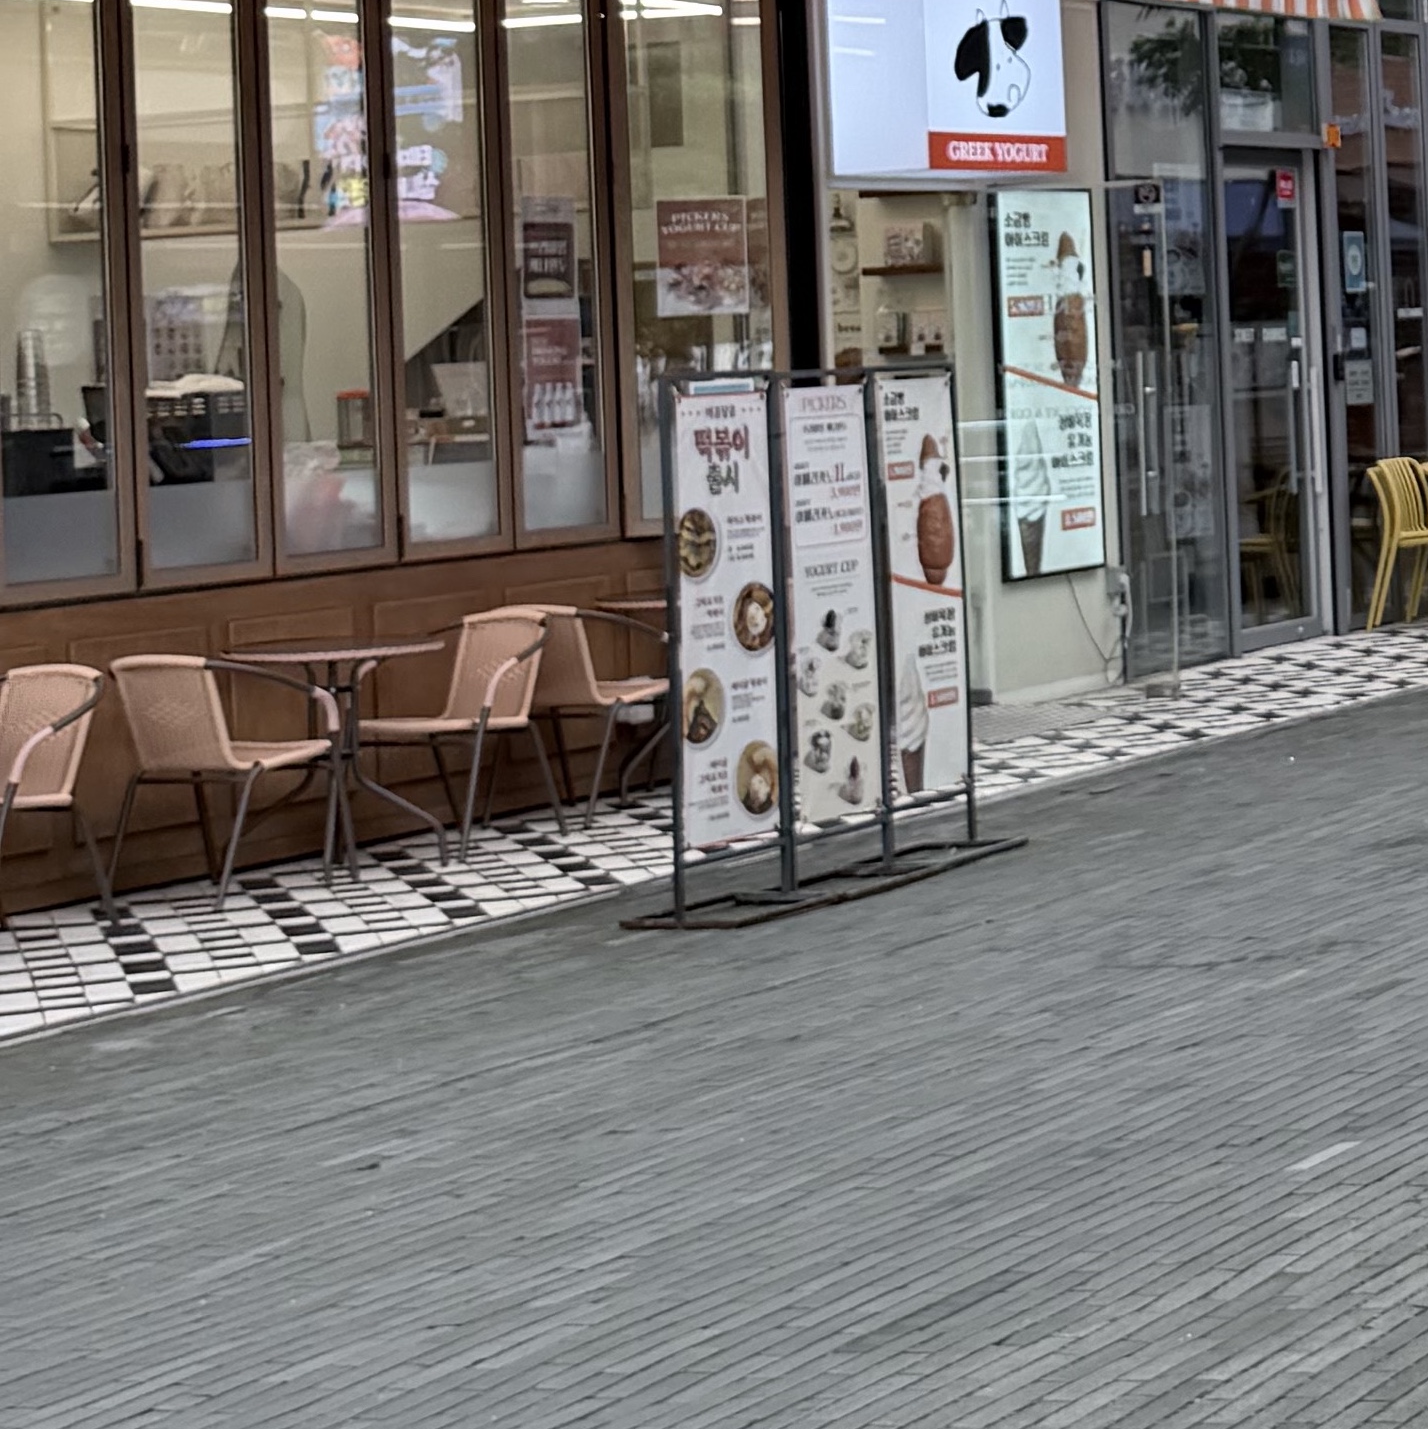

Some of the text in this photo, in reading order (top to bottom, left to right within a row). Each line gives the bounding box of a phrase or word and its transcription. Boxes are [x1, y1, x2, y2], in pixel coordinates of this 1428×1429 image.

[949, 140, 1049, 163] GREEK YOGURT
[694, 424, 749, 462] 떡볶이
[706, 461, 739, 495] 출시
